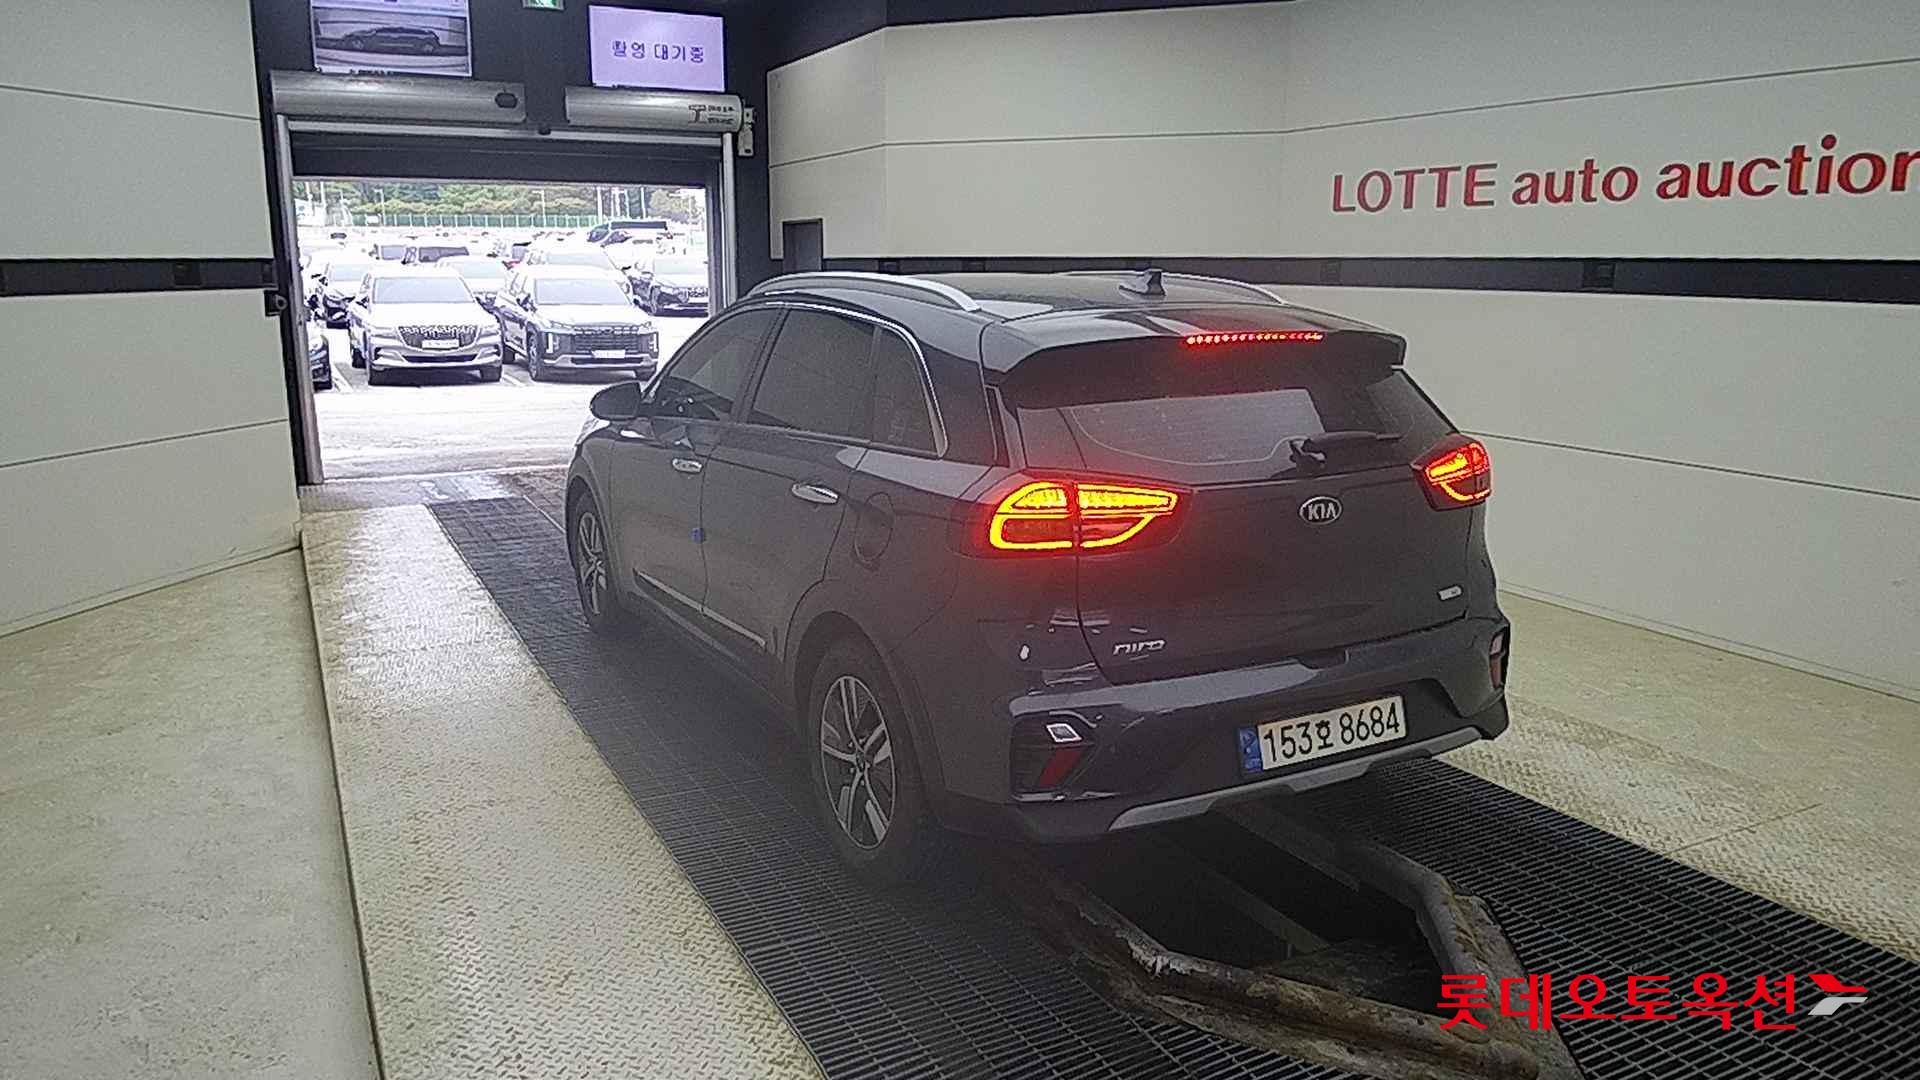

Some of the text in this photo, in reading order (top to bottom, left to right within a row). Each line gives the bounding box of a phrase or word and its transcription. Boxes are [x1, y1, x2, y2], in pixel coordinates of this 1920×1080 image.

[654, 44, 704, 63] 대기중
[1332, 163, 1498, 213] LOTTE
[1512, 158, 1639, 206] auto
[1307, 502, 1337, 520] KIA
[1263, 702, 1400, 763] 153호 8684
